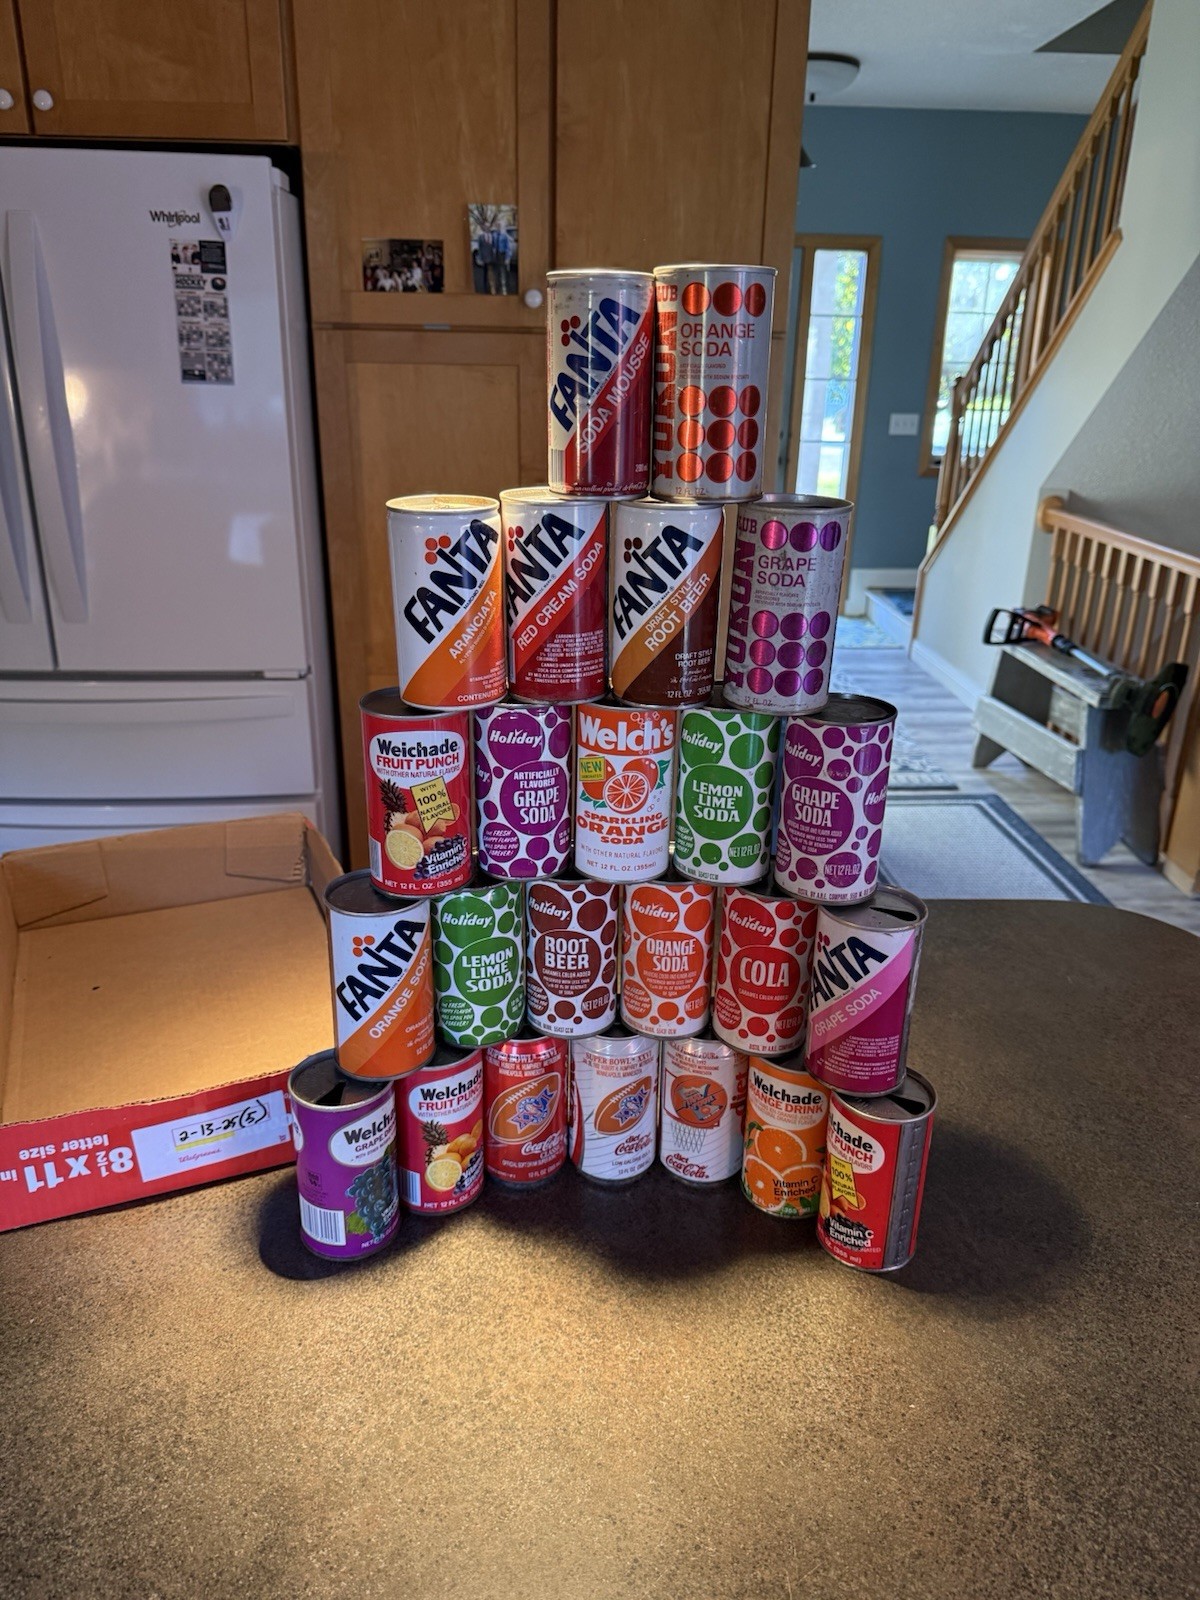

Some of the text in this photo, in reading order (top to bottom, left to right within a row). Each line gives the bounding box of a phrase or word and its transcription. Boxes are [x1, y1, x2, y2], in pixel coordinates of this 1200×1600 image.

[149, 210, 200, 228] Whirlpool
[680, 323, 755, 339] ORANGE
[680, 341, 732, 357] SODA
[550, 297, 641, 432] FANTA
[580, 332, 650, 454] SODA MOUSSE
[758, 555, 817, 571] GRAPE
[404, 518, 499, 644] FANTA
[612, 525, 704, 640] FANTA
[757, 571, 806, 587] SODA
[516, 541, 603, 652] RED CREAM SODA
[645, 577, 695, 632] DRAFT STYLE
[644, 573, 711, 652] ROOT BEER
[449, 590, 497, 659] ARANCIATA
[675, 652, 698, 660] DRAFT
[457, 688, 499, 702] CONTENUTO
[490, 729, 542, 748] Holiday
[579, 711, 674, 751] Welch's
[682, 729, 723, 754] Holiday
[377, 753, 459, 770] FRUIT PUNCH
[785, 739, 822, 767] Holiday
[377, 765, 460, 778] WITH OTHER NATURAL FLAVORS
[513, 767, 560, 780] ARTIFICIALLY
[580, 761, 602, 773] NEW
[420, 784, 437, 793] WITH
[520, 778, 555, 789] FLAVORED
[692, 779, 743, 797] LEMON
[513, 786, 560, 808] GRAPE
[699, 794, 736, 810] LIME
[792, 784, 841, 810] GRAPE
[420, 801, 451, 815] NATURAL
[422, 806, 452, 822] FLAVORS
[520, 805, 556, 825] SODA
[693, 805, 741, 823] SODA
[794, 803, 832, 827] SODA
[576, 815, 669, 837] ORANGE
[584, 810, 663, 825] SPARKLING
[600, 836, 644, 845] SODA
[424, 837, 468, 865] Vitamin C
[593, 848, 613, 858] OTHER
[643, 845, 664, 857] FLAVORS
[427, 847, 468, 875] Enriched
[384, 879, 398, 888] NET
[528, 897, 571, 921] Holiday
[632, 899, 678, 923] Holiday
[442, 911, 493, 929] Holiday
[729, 910, 775, 938] Holiday
[544, 936, 589, 954] ROOT
[646, 938, 696, 956] ORANGE
[462, 946, 513, 967] LEMON
[544, 953, 589, 970] BEER
[652, 955, 689, 972] SODA
[336, 919, 426, 1022] FANTA
[471, 961, 508, 979] LIME
[739, 956, 789, 988] COLA
[465, 975, 513, 993] SODA
[368, 987, 414, 1039] ORANGE
[409, 948, 429, 986] SODA
[814, 988, 882, 1036] GRAPE SODA
[585, 1051, 608, 1064] SUPER
[609, 1058, 632, 1066] BOWL
[753, 1071, 822, 1105] Welchade
[418, 1098, 455, 1111] FRUIT
[784, 1102, 823, 1114] DRINK
[19, 1134, 109, 1160] letter size
[355, 1133, 384, 1152] GRAPE
[614, 1132, 651, 1156] Coca-Cola
[625, 1133, 641, 1144] diet
[179, 1149, 222, 1163] Walgreens
[673, 1152, 689, 1164] diet
[834, 1136, 873, 1163] PUNCH
[665, 1154, 707, 1179] Coca-Cola
[849, 1157, 873, 1171] FLAVORS
[0, 1169, 18, 1181] in
[24, 1161, 64, 1193] 11
[773, 1175, 818, 1188] Vitamin C
[774, 1185, 816, 1196] Enriched
[829, 1217, 874, 1239] Vitamin C
[829, 1226, 872, 1247] Enriched
